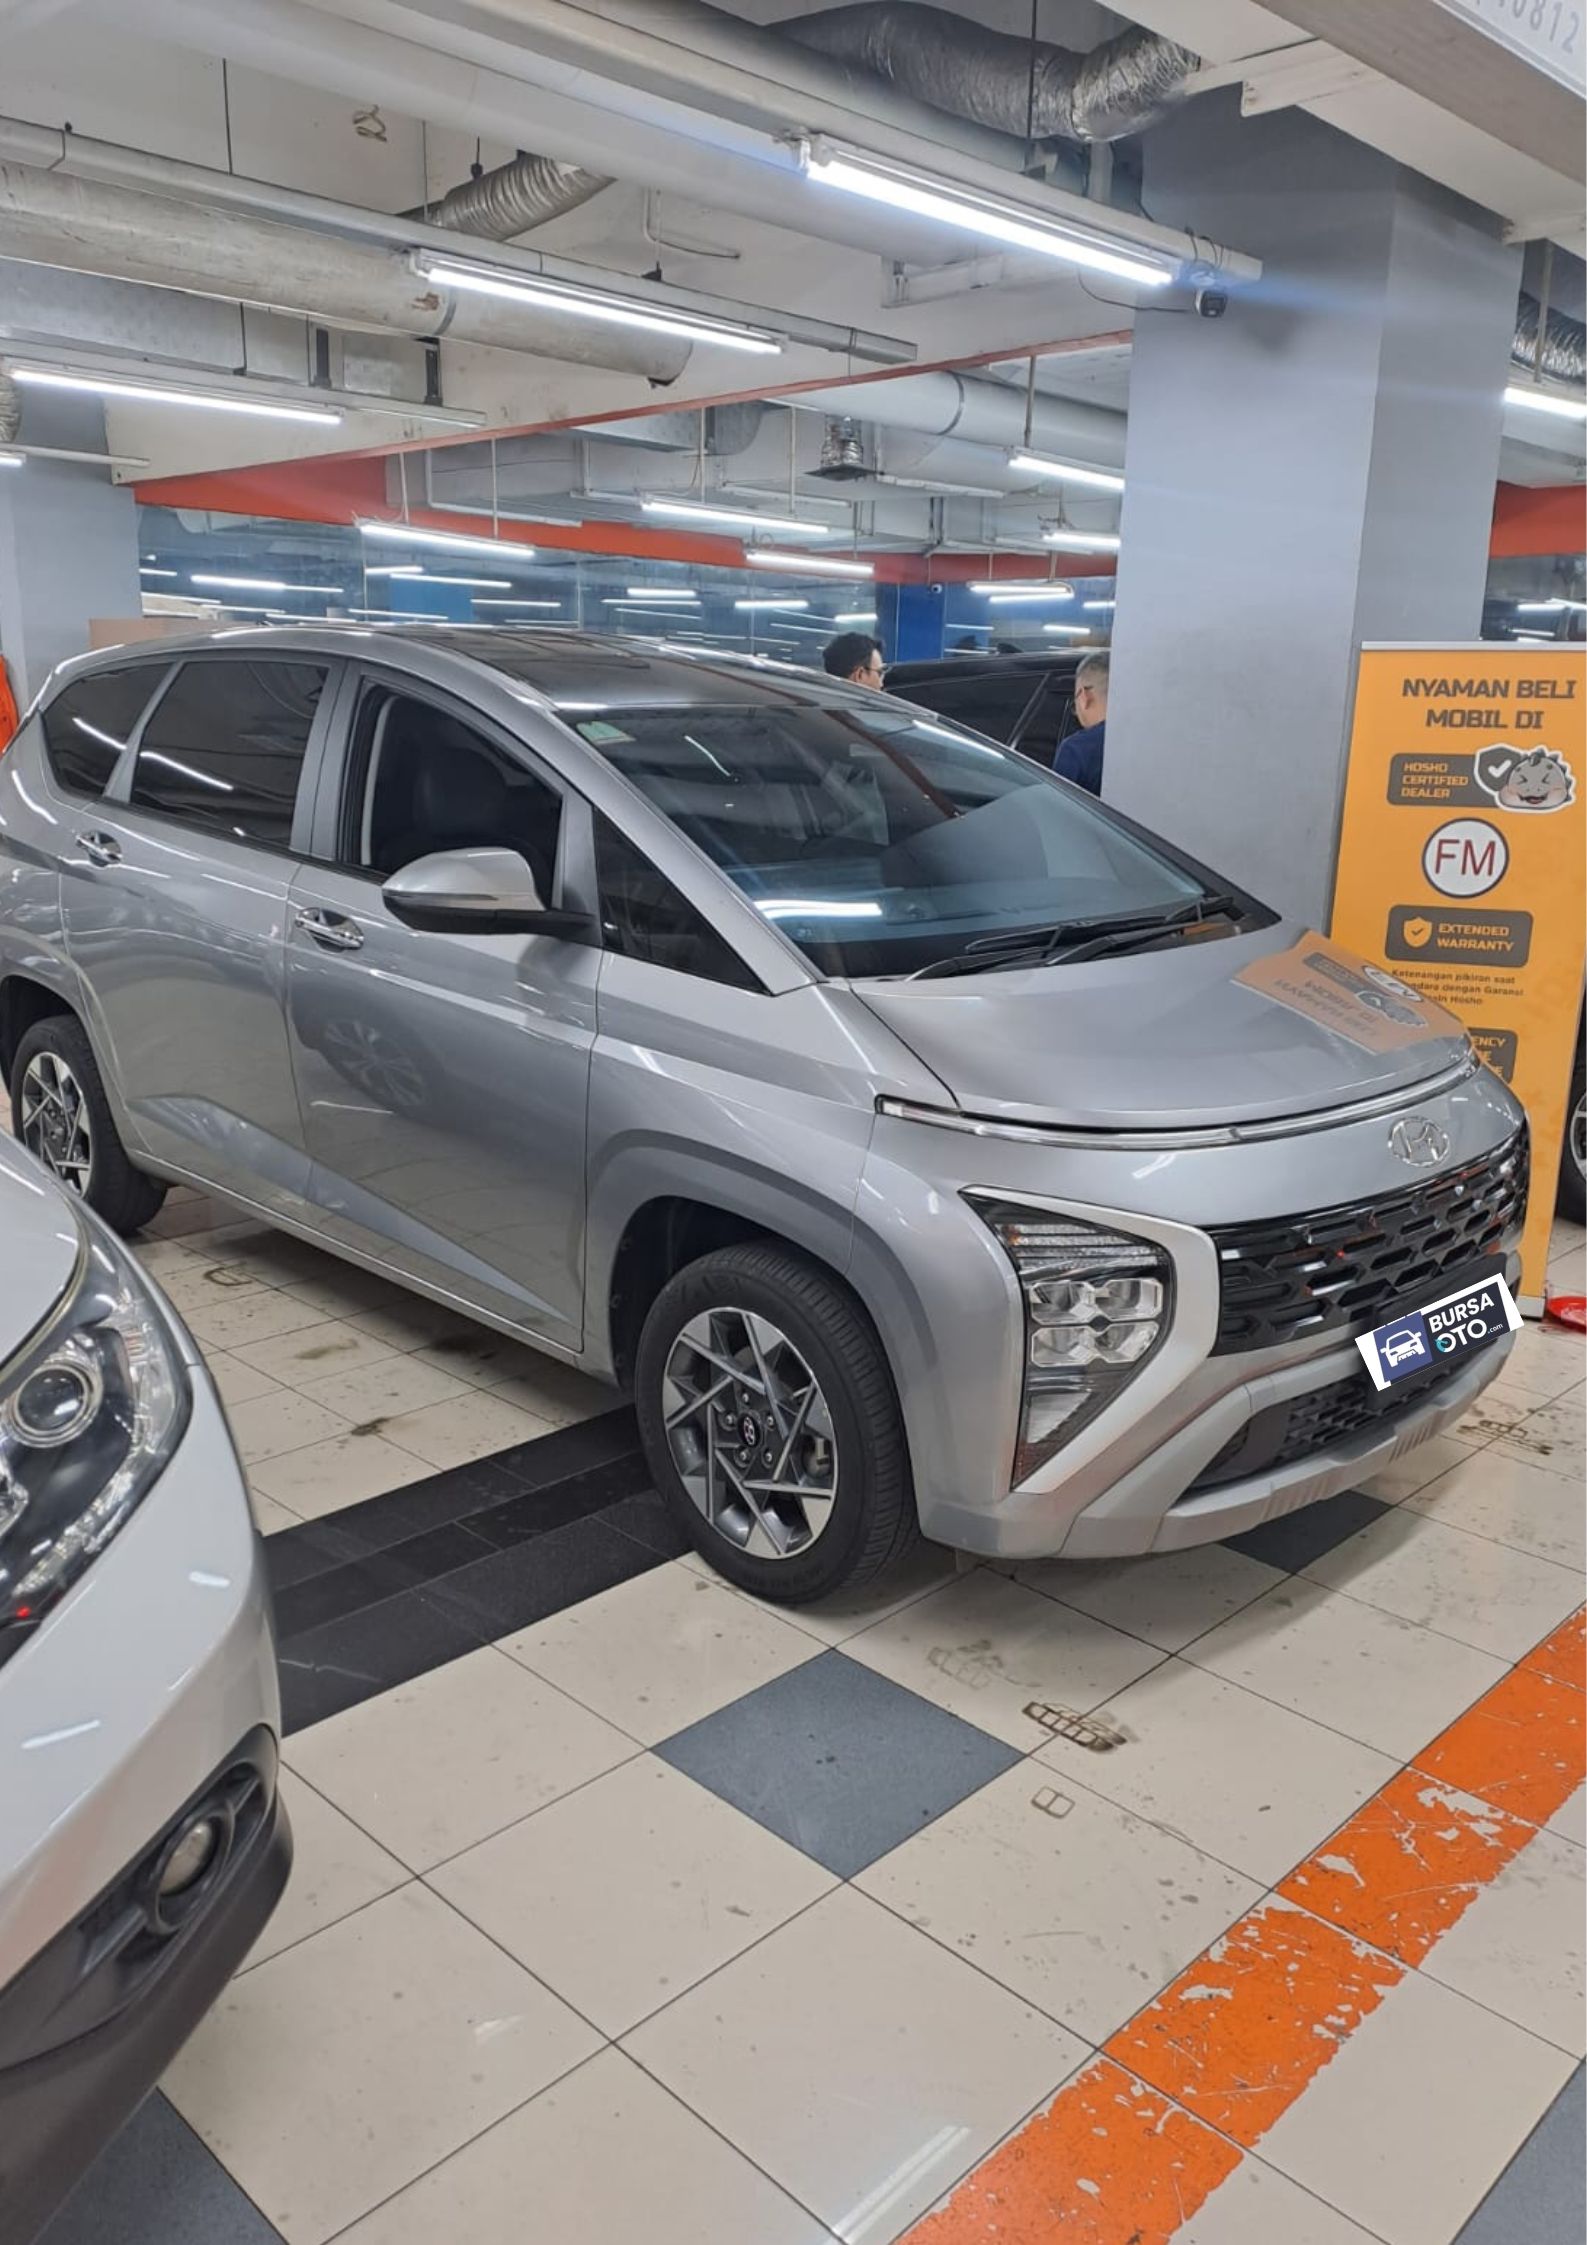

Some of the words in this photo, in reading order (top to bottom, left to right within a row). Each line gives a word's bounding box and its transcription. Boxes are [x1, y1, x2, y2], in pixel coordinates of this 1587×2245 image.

[1402, 678, 1510, 698] NYAMAN
[1516, 680, 1577, 699] BELI
[1425, 709, 1508, 728] MOBIL
[1514, 711, 1544, 729] DI
[1403, 762, 1448, 773] HOSHO
[1402, 775, 1469, 786] CERTIFIED
[1400, 787, 1451, 798] DEALER
[1435, 838, 1496, 876] FM
[1438, 923, 1510, 936] EXTENDED
[1437, 937, 1514, 951] WARRANTY
